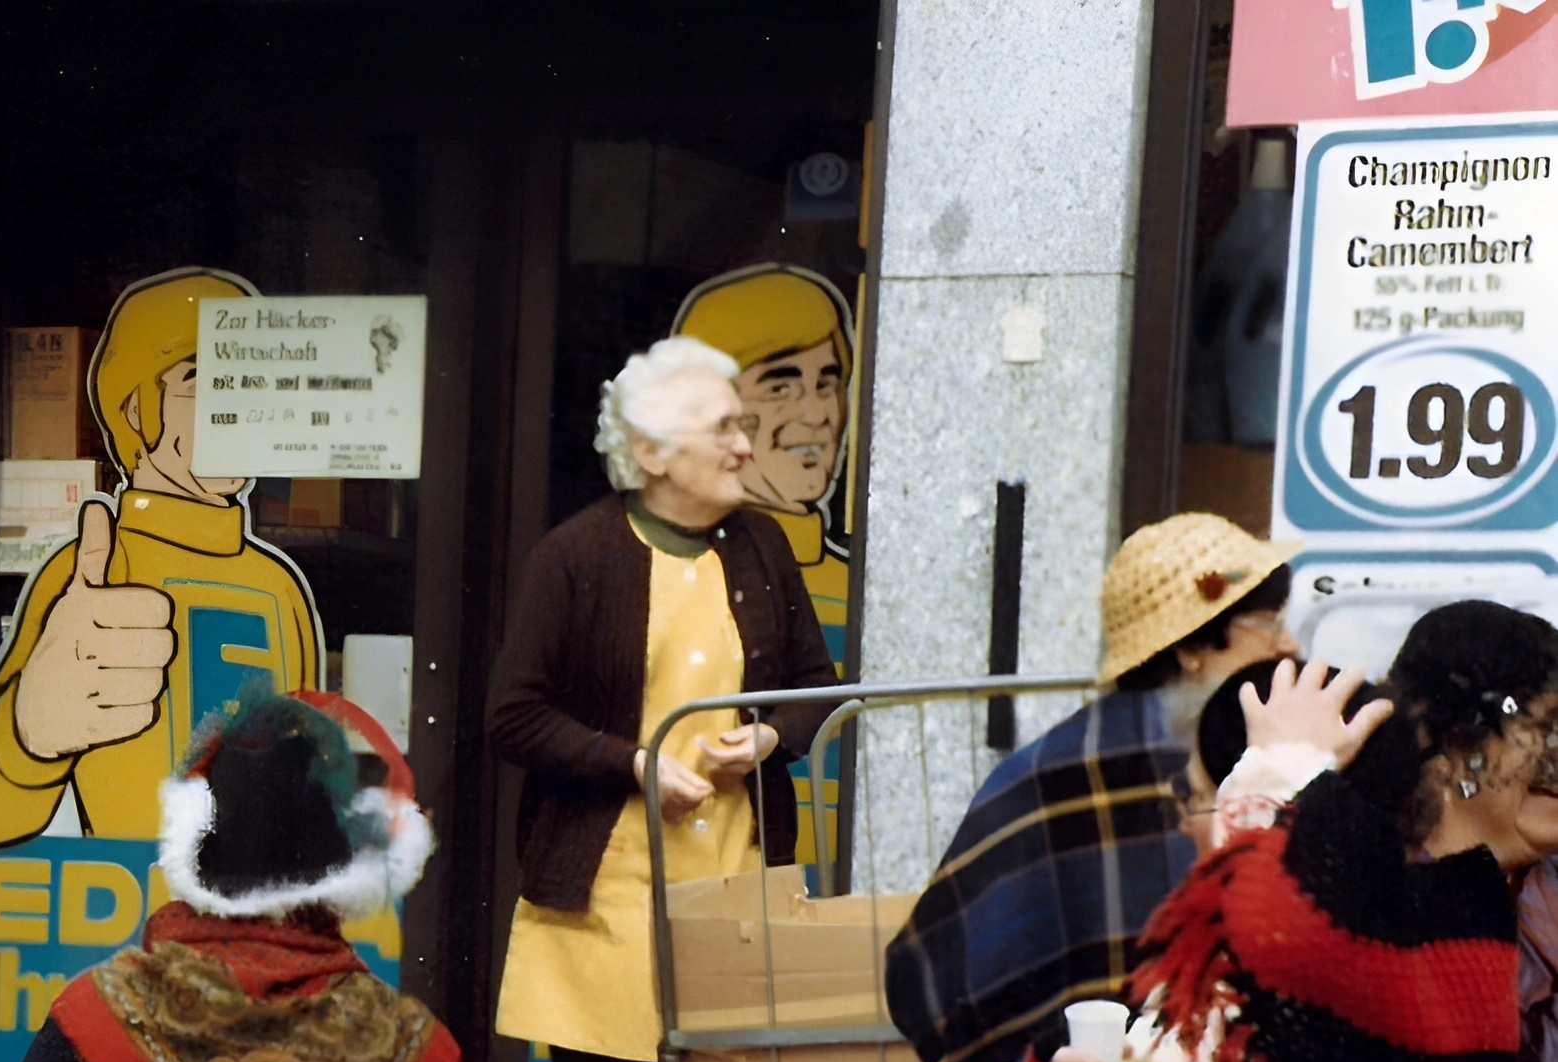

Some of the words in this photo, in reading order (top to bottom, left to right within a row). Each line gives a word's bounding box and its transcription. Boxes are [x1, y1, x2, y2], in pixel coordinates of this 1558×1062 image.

[1348, 151, 1551, 191] Champignon
[1394, 198, 1498, 230] Rahm-
[1347, 234, 1532, 268] Camembert
[1353, 307, 1392, 330] 125
[1338, 382, 1526, 479] 1.99
